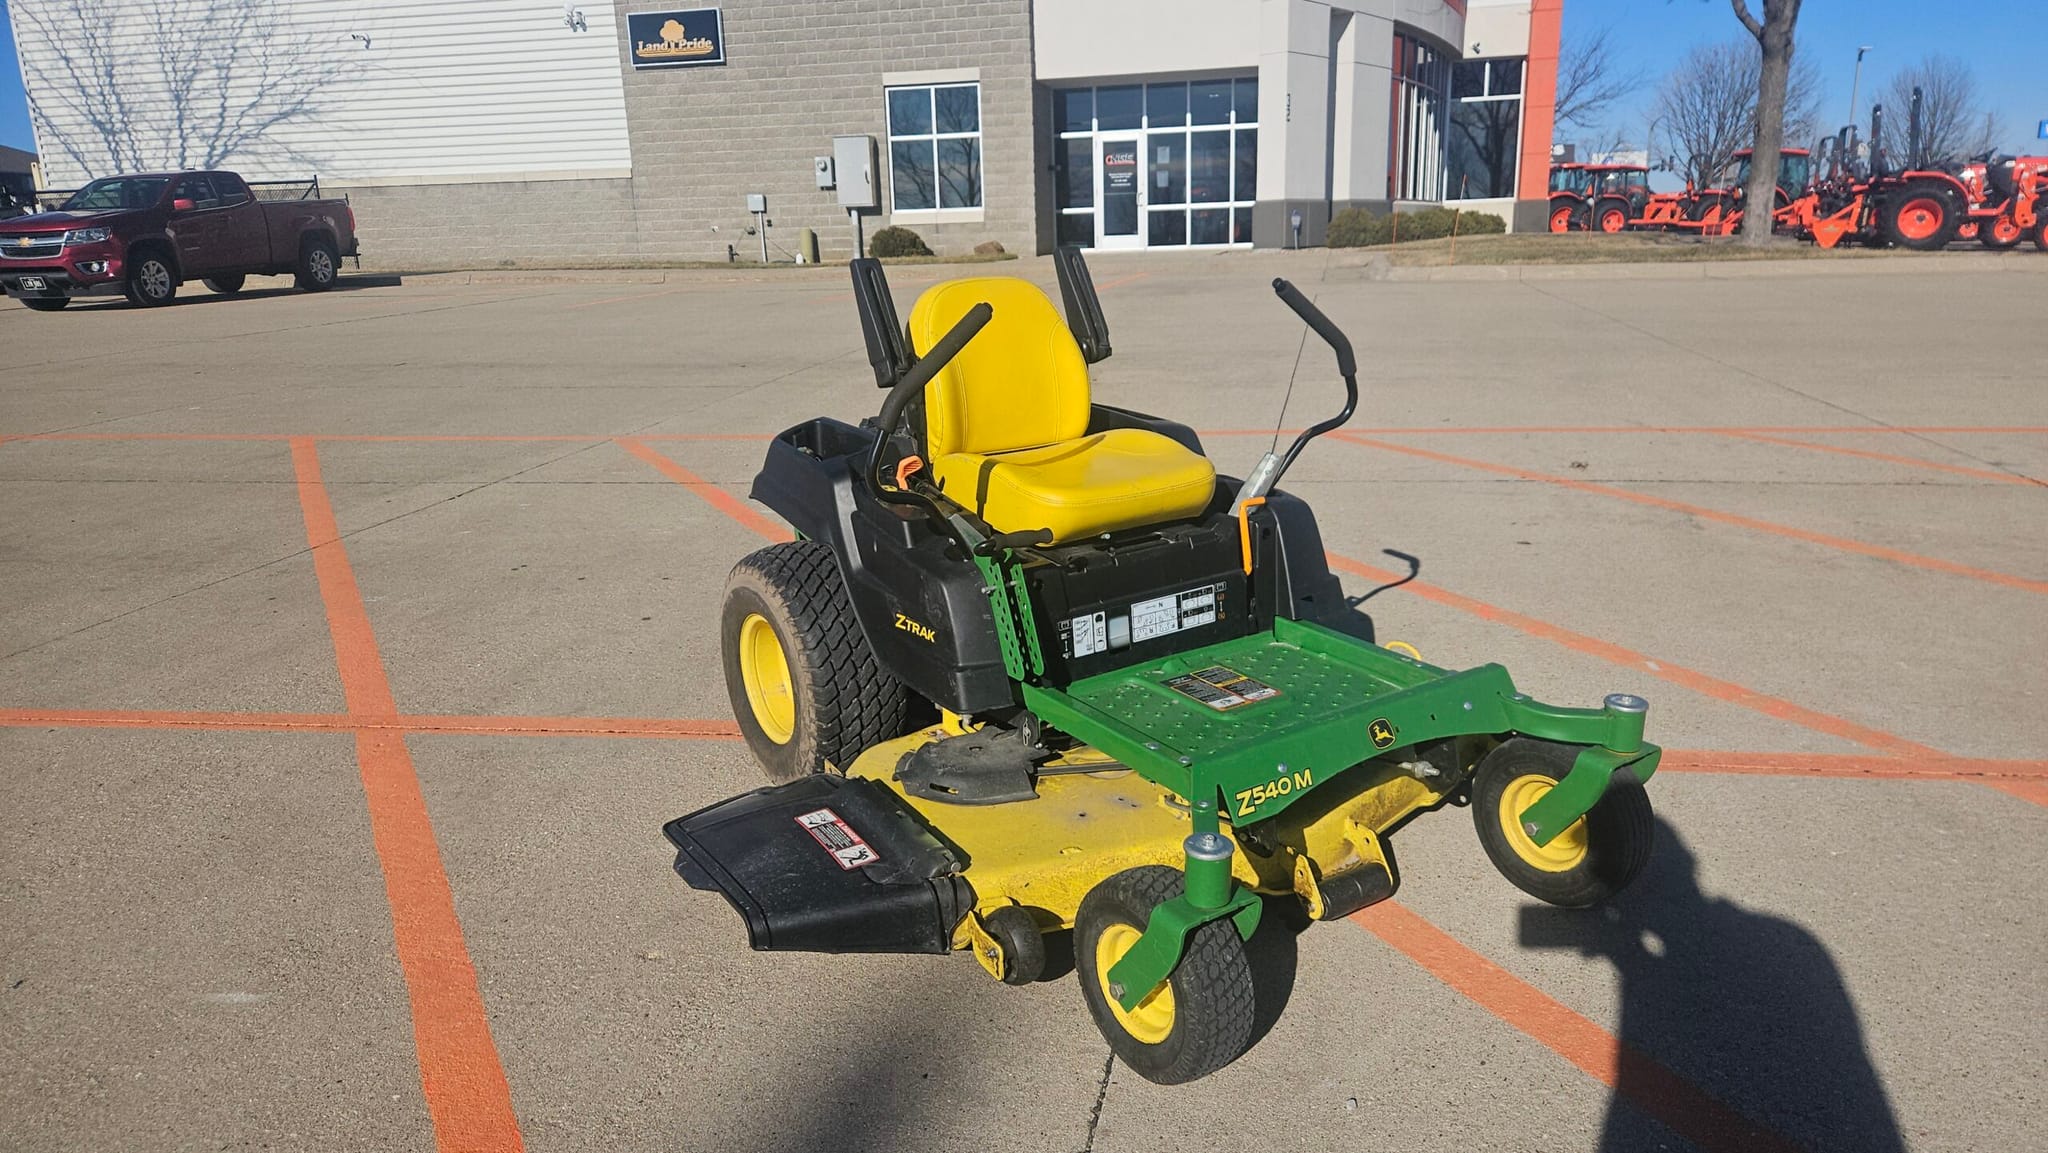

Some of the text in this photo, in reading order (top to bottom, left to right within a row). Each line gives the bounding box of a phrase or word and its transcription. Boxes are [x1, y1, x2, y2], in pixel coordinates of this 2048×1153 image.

[638, 37, 713, 52] Land Pride
[895, 613, 936, 643] ZTRAK
[1235, 767, 1313, 817] Z540 M
